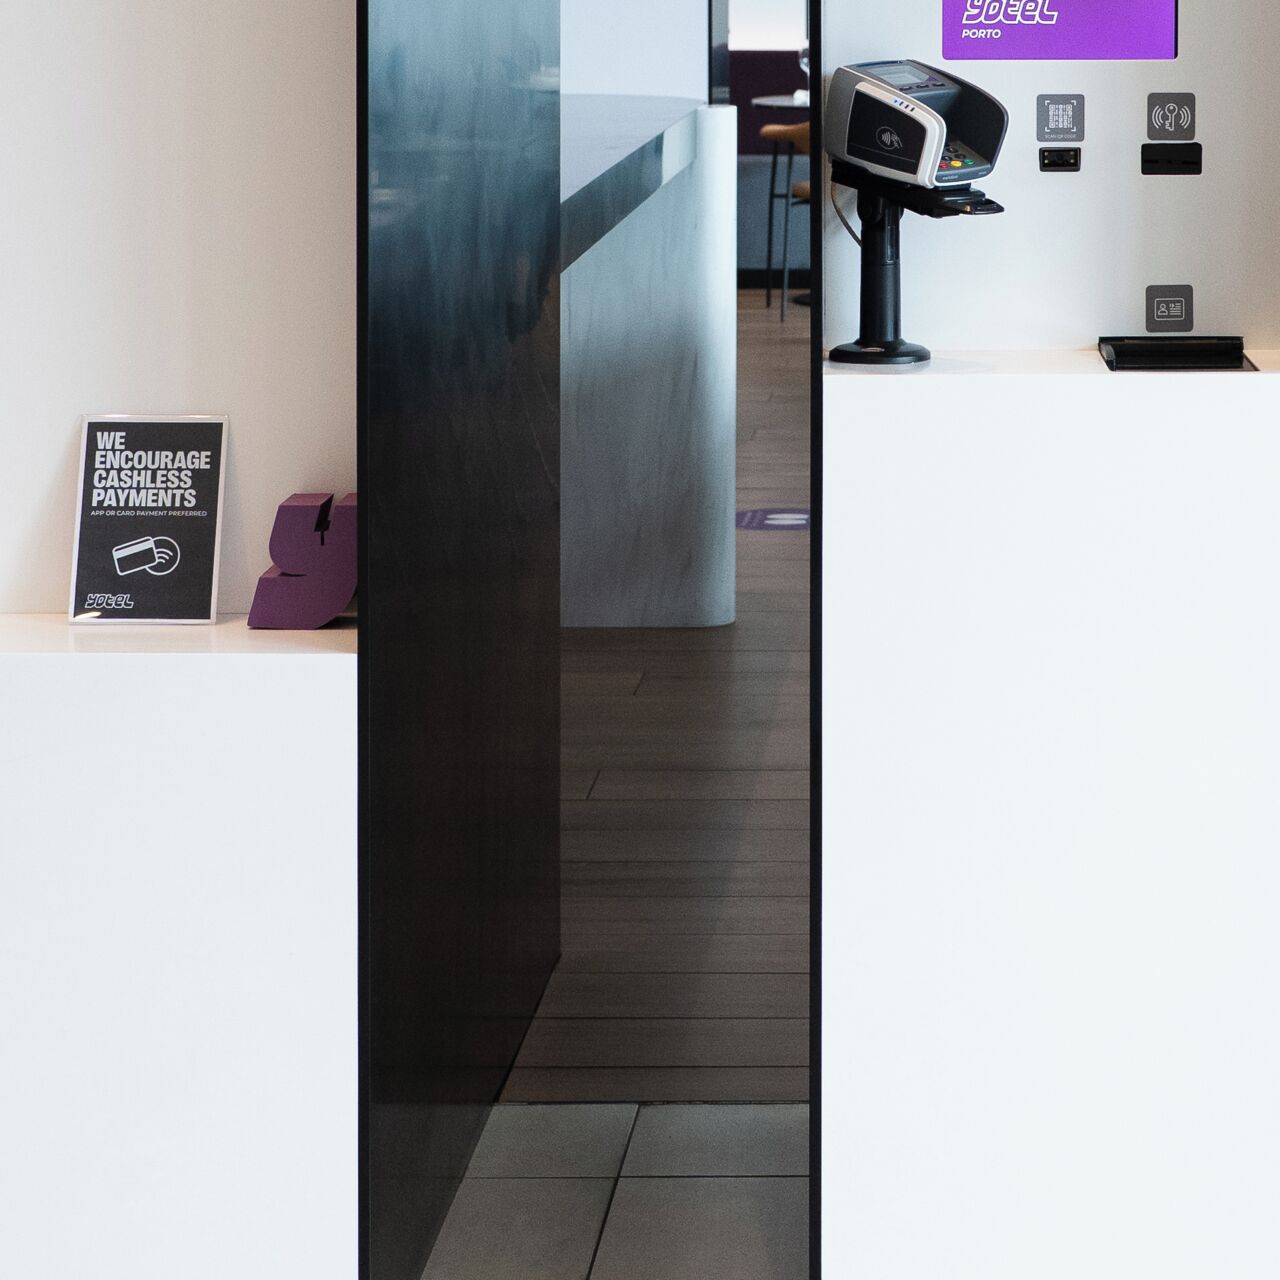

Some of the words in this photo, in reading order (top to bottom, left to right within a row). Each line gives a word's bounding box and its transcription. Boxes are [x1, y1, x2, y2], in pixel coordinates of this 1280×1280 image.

[961, 29, 1002, 39] PORTO
[96, 431, 126, 451] WE
[94, 450, 211, 470] ENCOURAGE
[93, 469, 192, 489] CASHLESS
[91, 488, 197, 508] PAYMENTS
